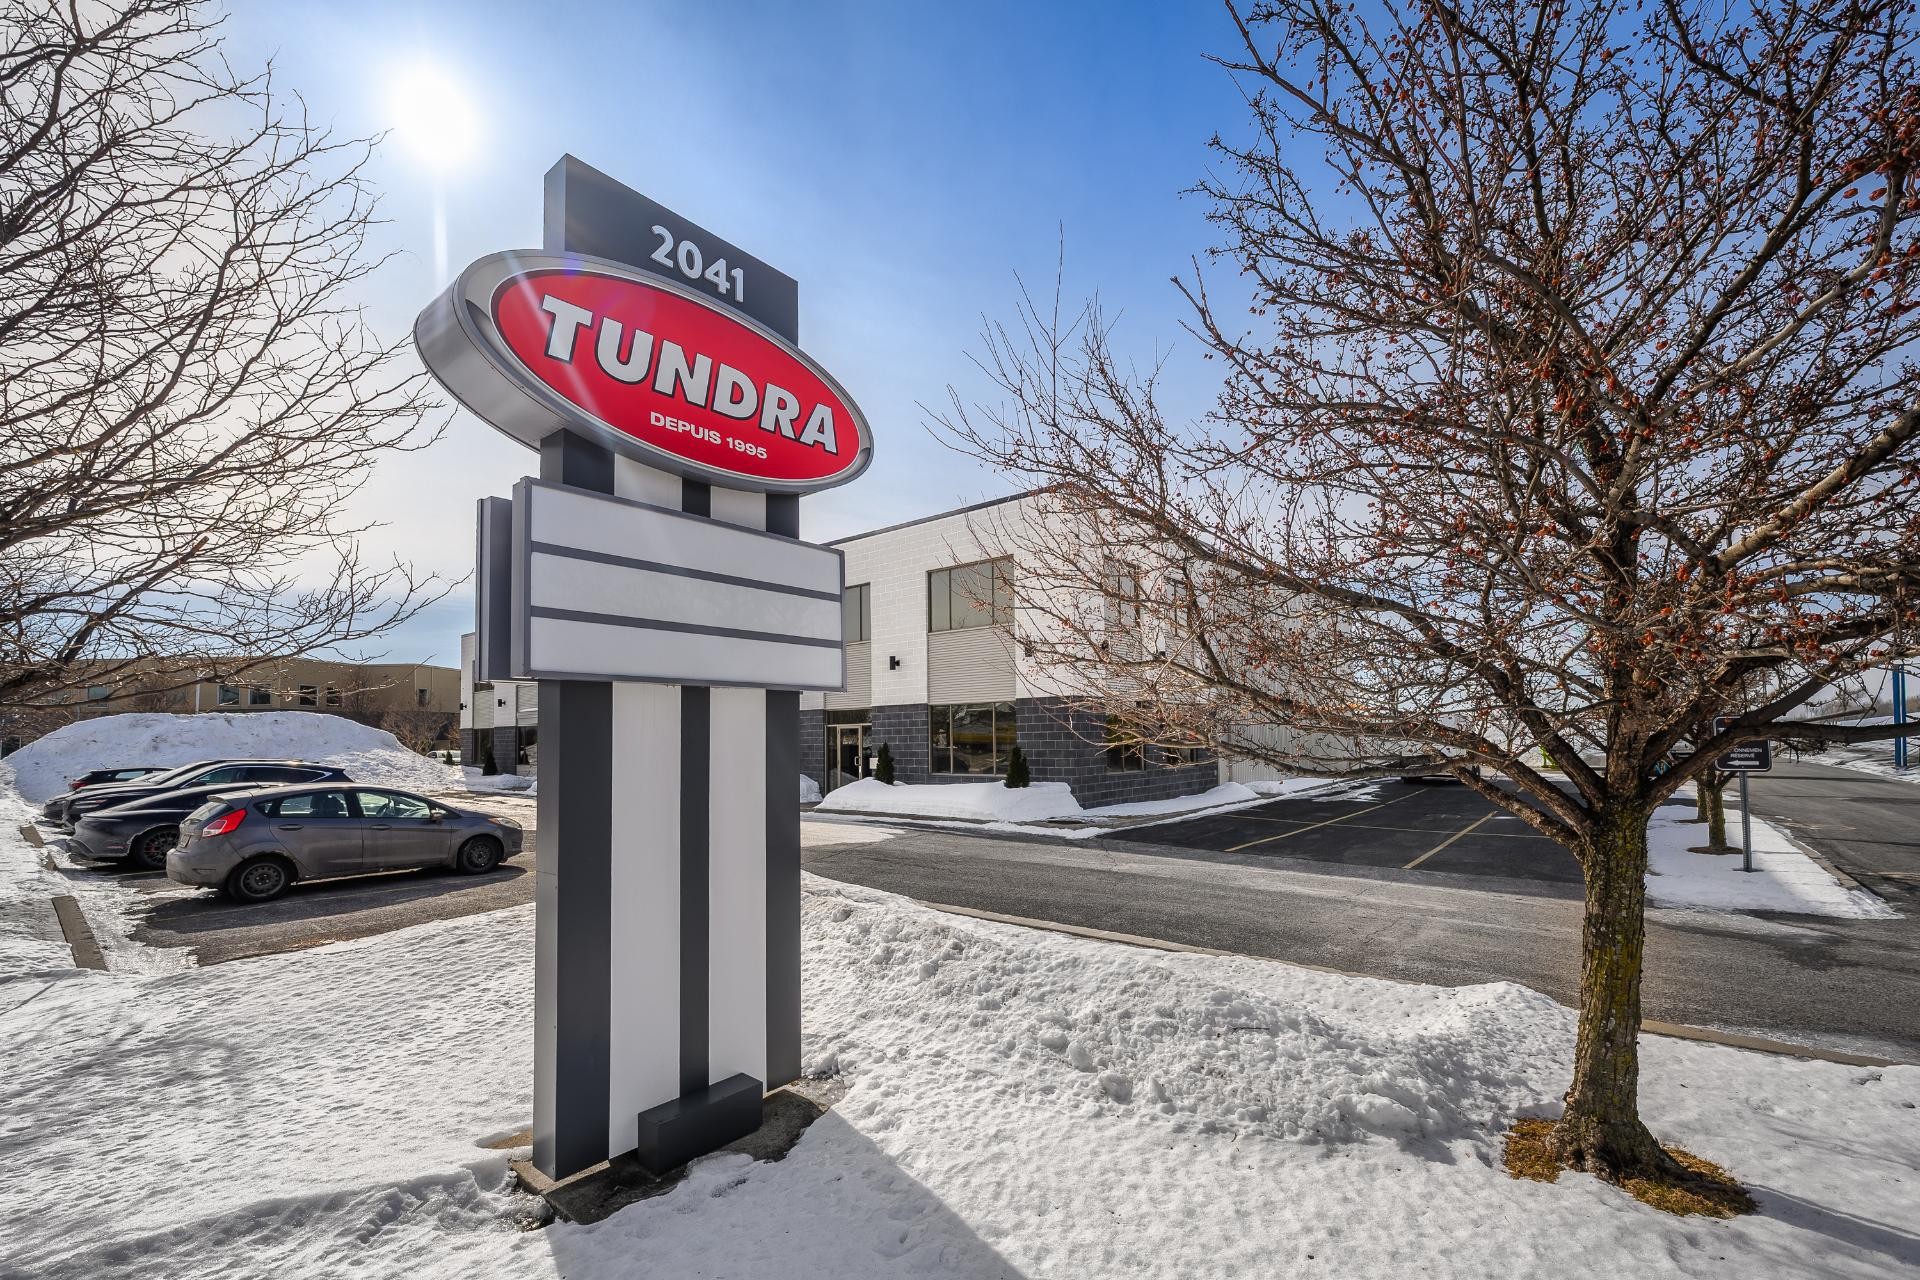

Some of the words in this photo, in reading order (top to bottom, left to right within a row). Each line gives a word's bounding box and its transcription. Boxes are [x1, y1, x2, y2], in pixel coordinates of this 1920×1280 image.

[650, 225, 744, 303] 2041
[541, 294, 838, 454] TUNDRA
[650, 411, 722, 445] DEPUIS
[726, 437, 767, 459] 1995
